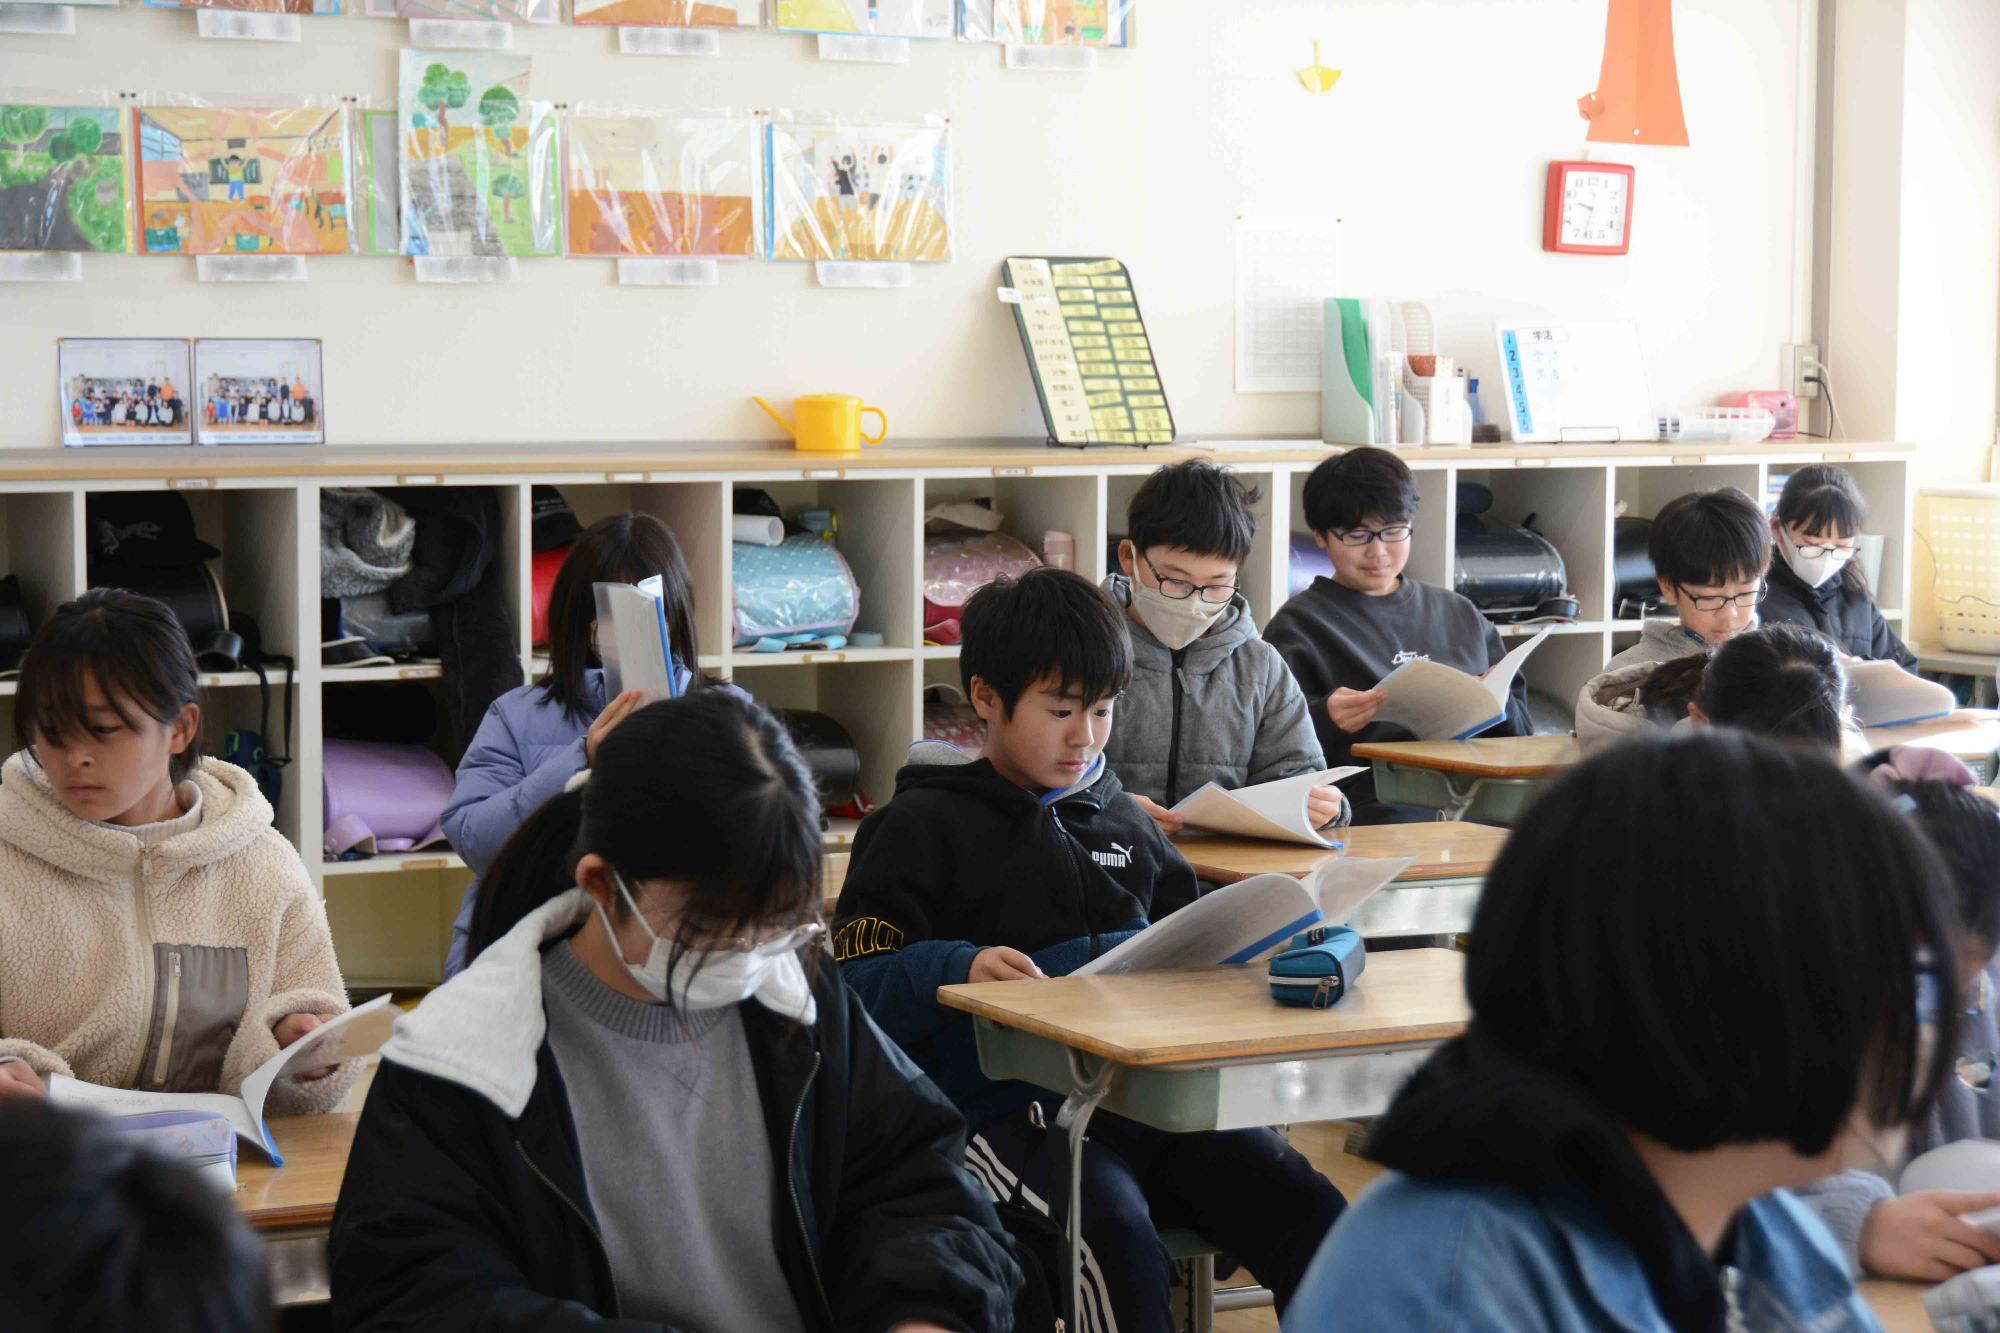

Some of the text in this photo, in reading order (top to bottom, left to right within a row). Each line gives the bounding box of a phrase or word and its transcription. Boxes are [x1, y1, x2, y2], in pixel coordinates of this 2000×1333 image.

[1575, 178, 1584, 187] 11
[1587, 176, 1599, 186] 12
[1509, 350, 1517, 361] 2
[1513, 367, 1520, 378] 3
[1516, 383, 1523, 396] 4
[1518, 401, 1526, 413] 5
[1092, 851, 1126, 868] PUMA
